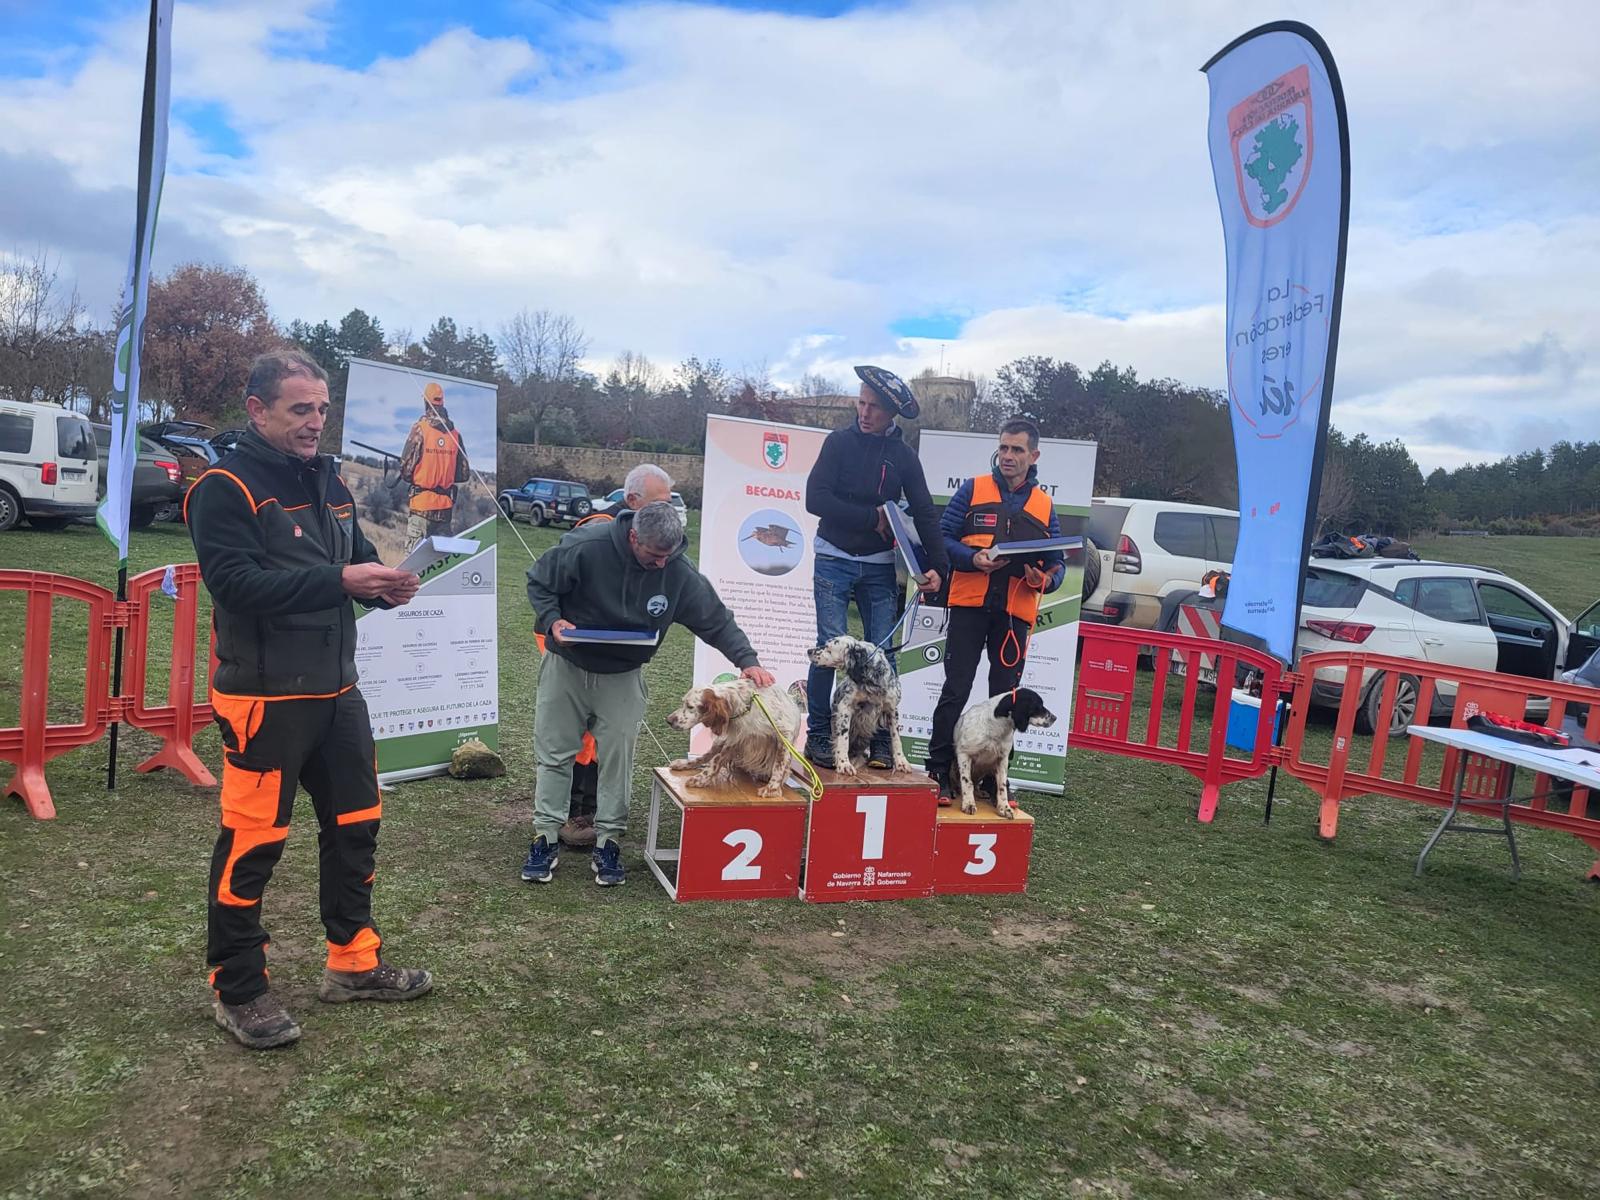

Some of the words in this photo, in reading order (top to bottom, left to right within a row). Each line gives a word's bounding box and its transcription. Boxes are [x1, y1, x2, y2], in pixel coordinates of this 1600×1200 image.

[745, 485, 801, 501] BECADAS
[398, 610, 422, 618] SEGUROS
[423, 609, 430, 617] DE
[430, 608, 444, 616] CAZA
[389, 708, 412, 718] PROTEGE
[855, 795, 888, 860] 1
[720, 828, 764, 881] 2
[963, 833, 998, 876] 3
[832, 872, 862, 880] Gobierno
